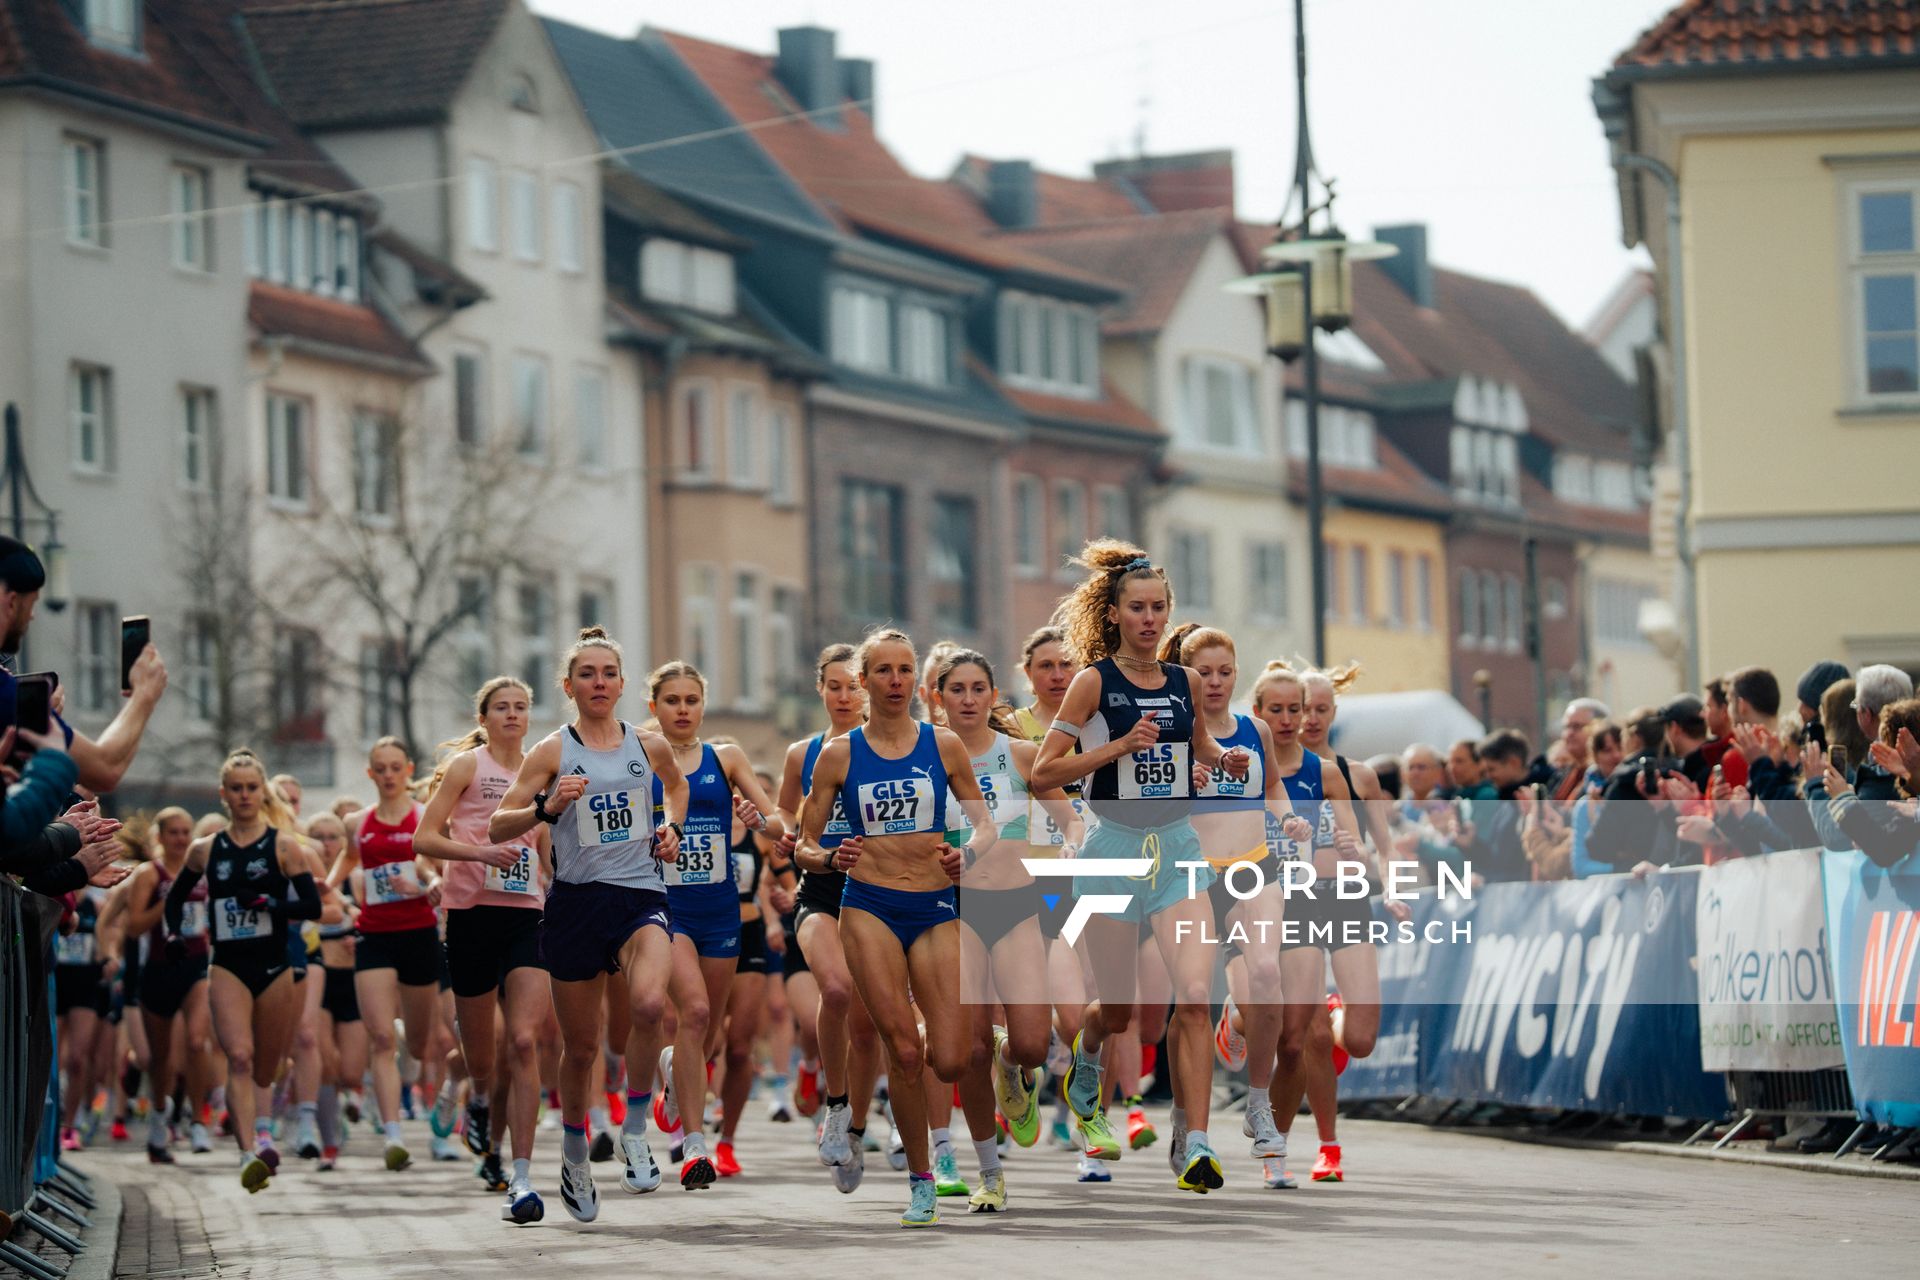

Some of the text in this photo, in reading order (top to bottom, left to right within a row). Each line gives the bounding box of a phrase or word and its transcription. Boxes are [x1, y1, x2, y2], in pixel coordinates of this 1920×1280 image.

[1134, 762, 1176, 785] 659
[593, 808, 633, 832] 180
[876, 797, 919, 822] 227
[612, 831, 628, 839] PLAN
[896, 821, 915, 829] PLAN
[676, 851, 714, 872] 933
[226, 909, 259, 928] 974
